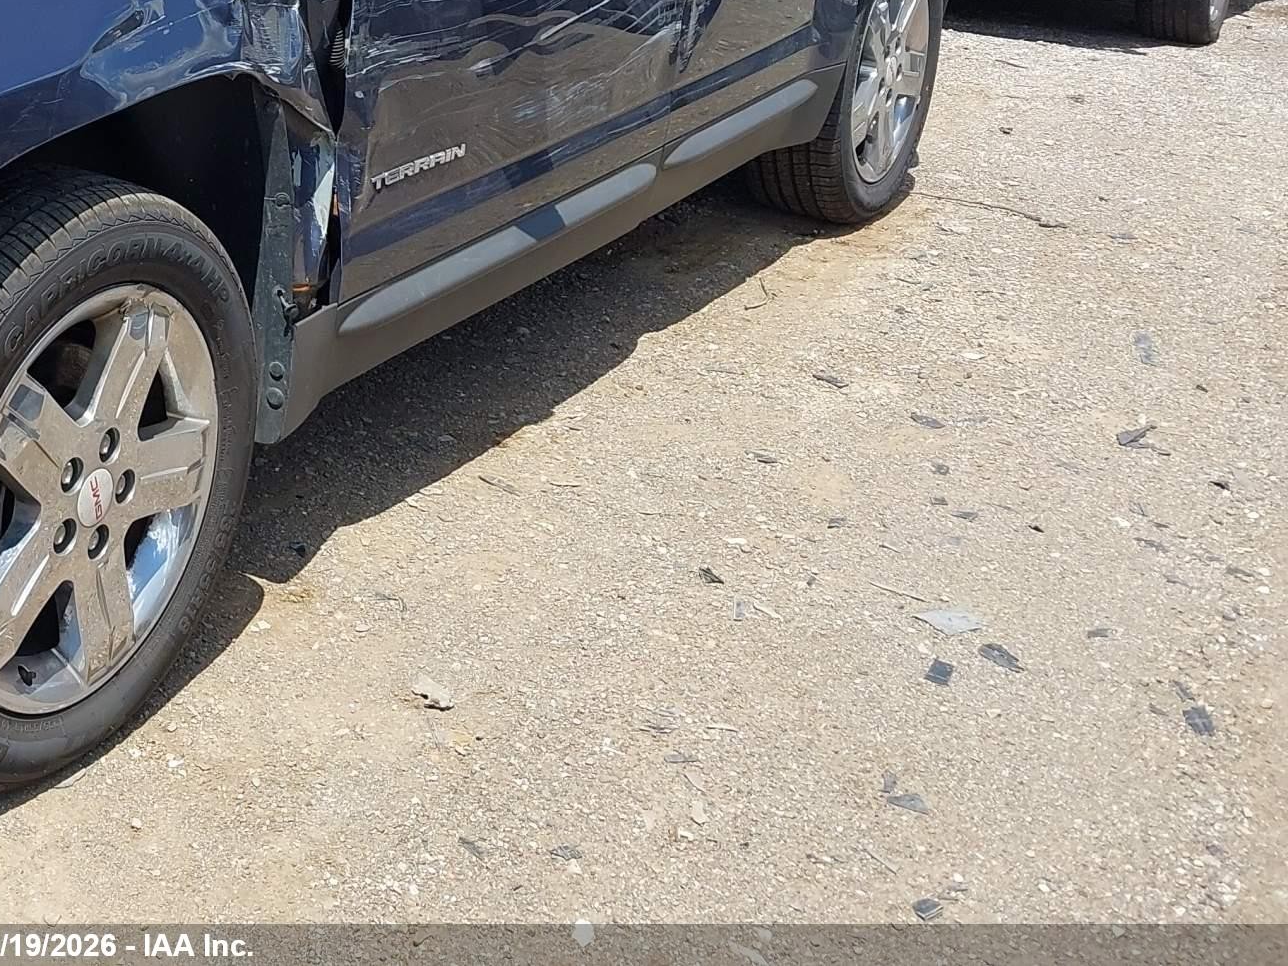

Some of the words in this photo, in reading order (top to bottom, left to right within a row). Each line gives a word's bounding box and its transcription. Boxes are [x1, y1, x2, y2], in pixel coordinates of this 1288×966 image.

[370, 143, 467, 190] TERRAIN
[3, 236, 161, 356] CAPRICORN
[90, 476, 103, 520] GMC
